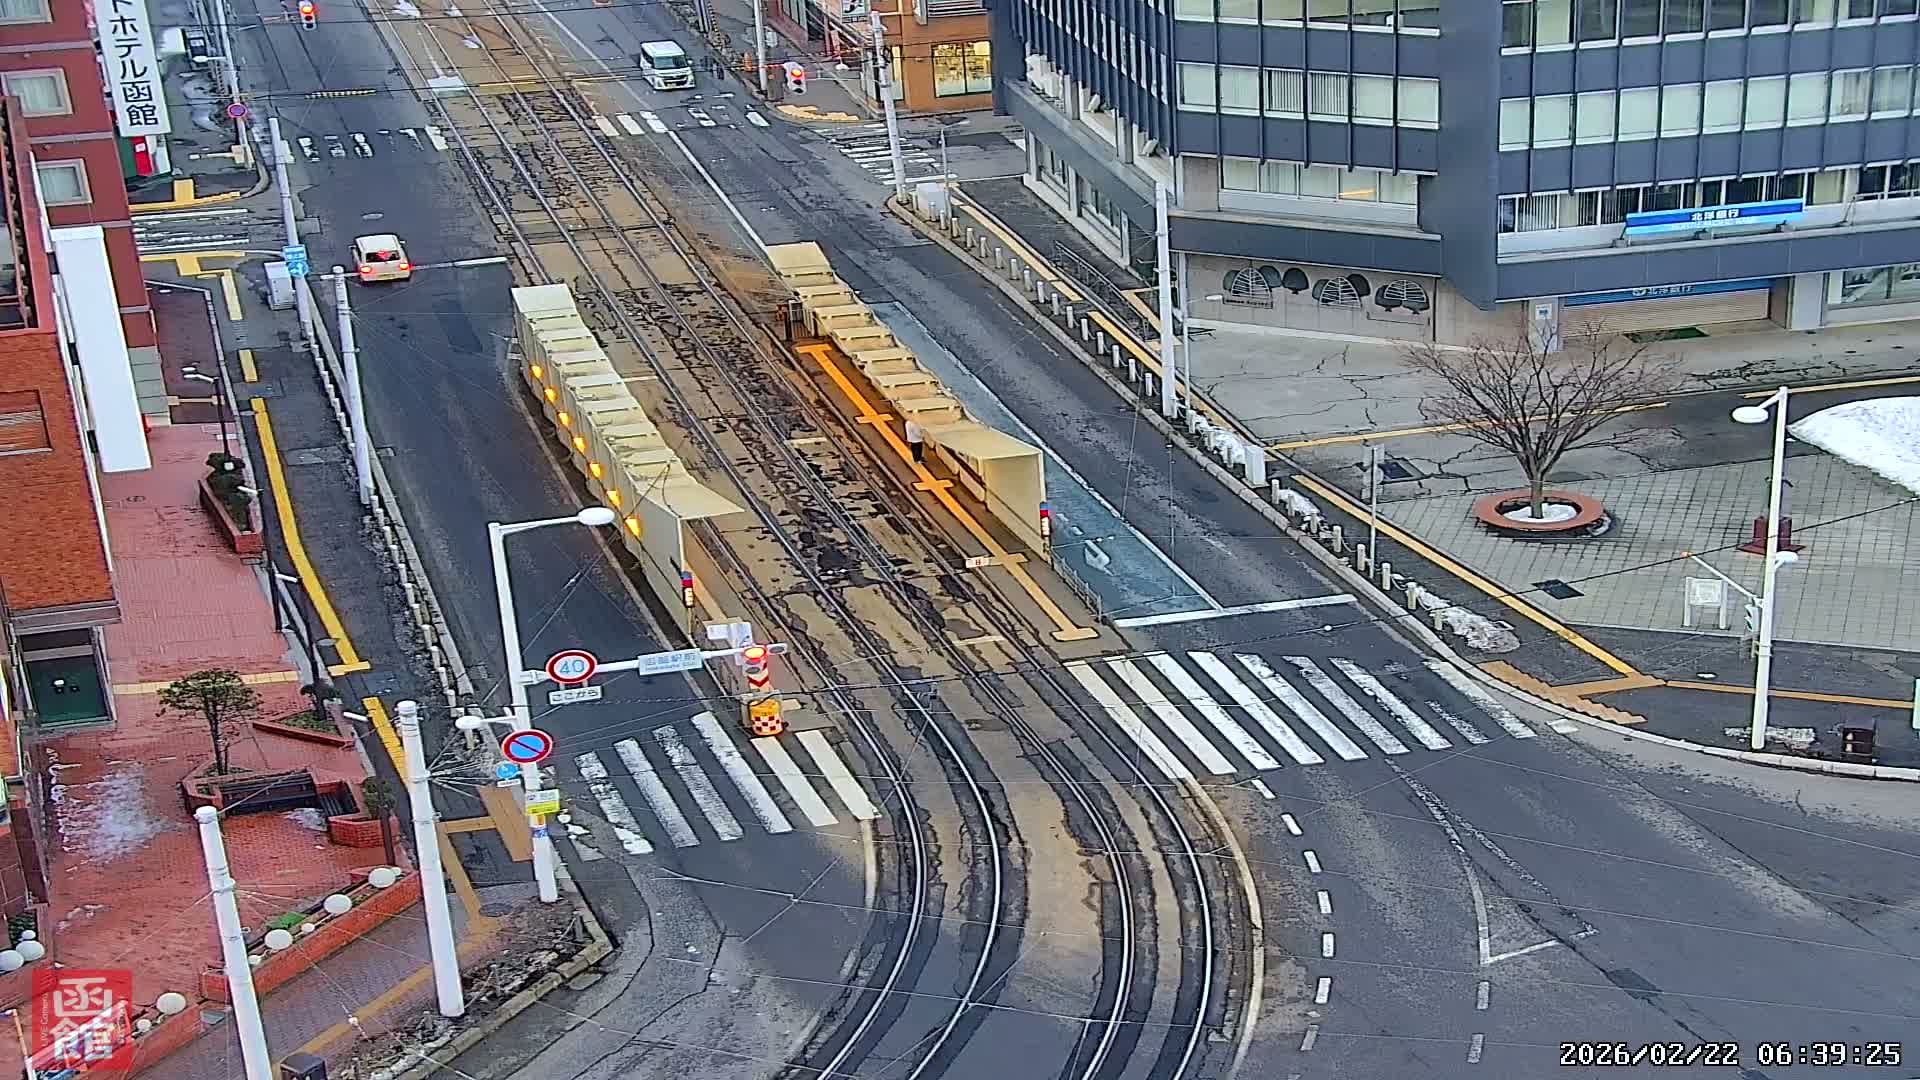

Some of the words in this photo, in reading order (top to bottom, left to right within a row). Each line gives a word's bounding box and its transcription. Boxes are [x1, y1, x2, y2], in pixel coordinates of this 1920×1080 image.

[1691, 209, 1739, 221] 北洋銀行
[560, 660, 585, 673] 40
[552, 690, 599, 701] ここから
